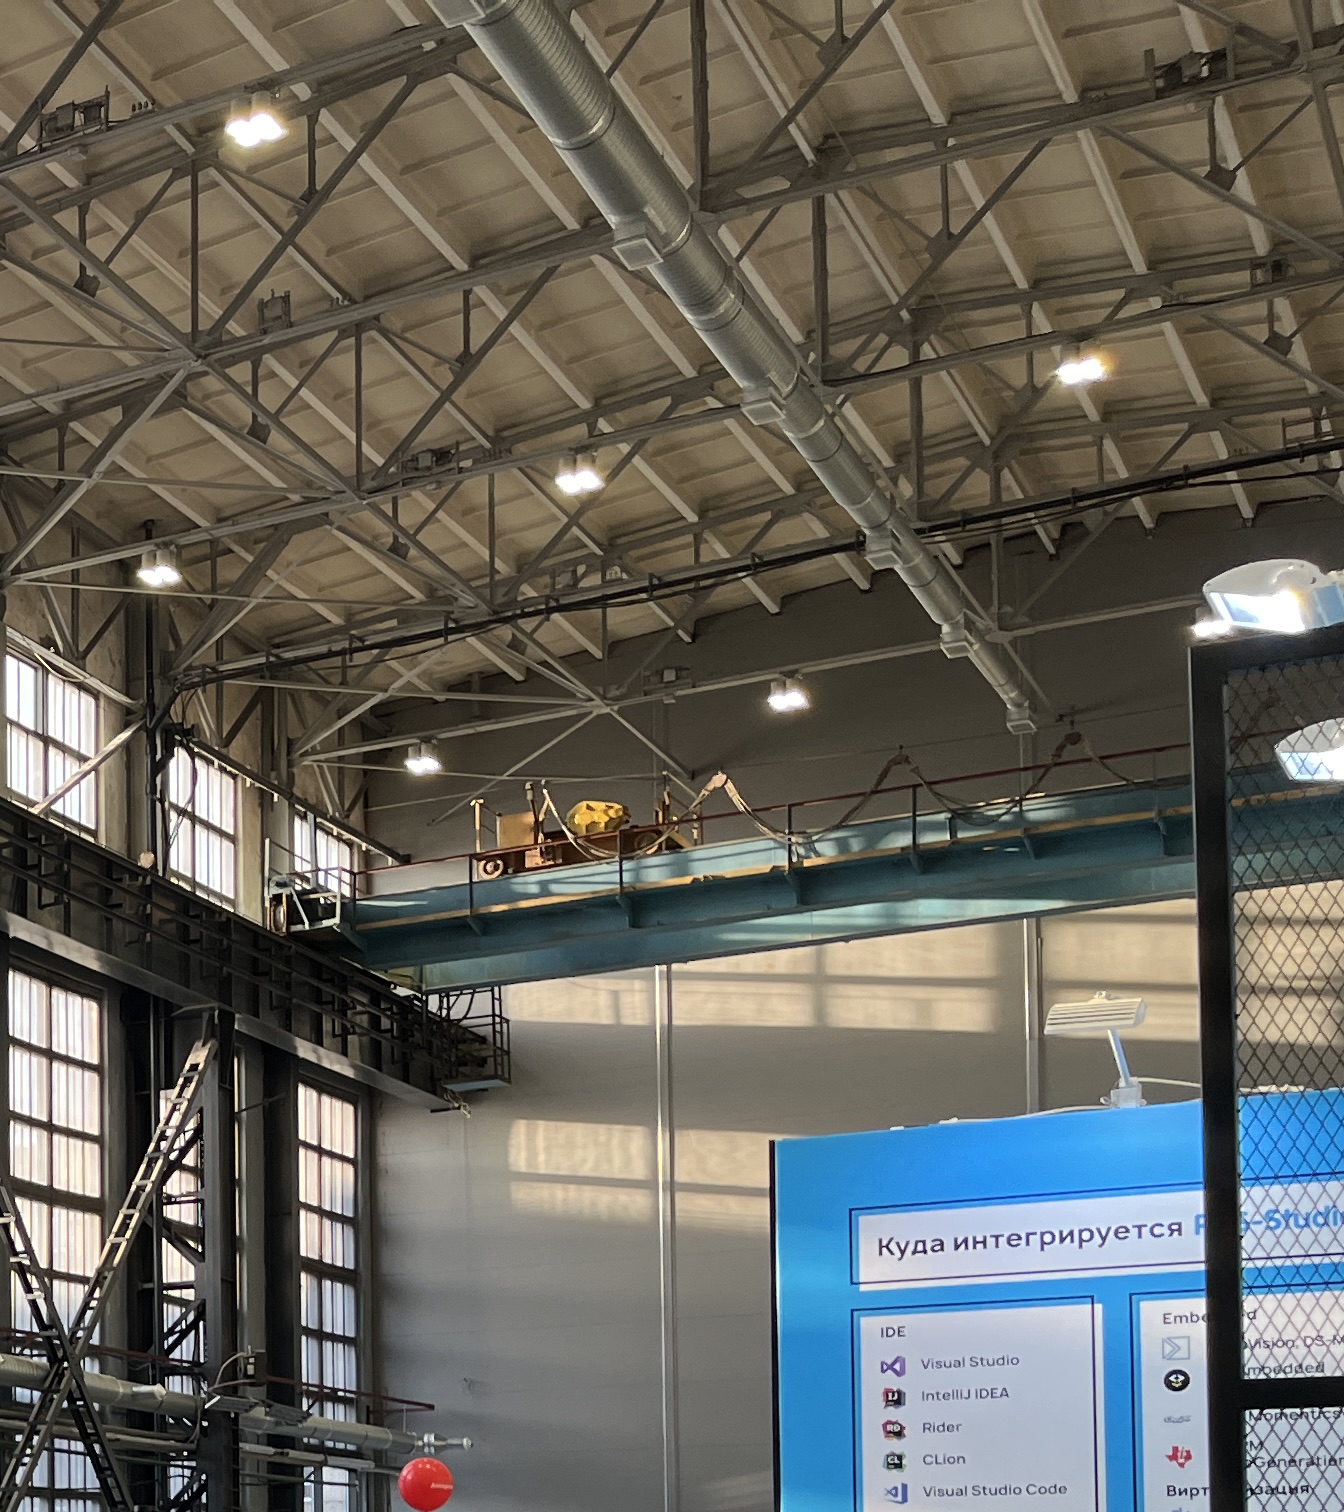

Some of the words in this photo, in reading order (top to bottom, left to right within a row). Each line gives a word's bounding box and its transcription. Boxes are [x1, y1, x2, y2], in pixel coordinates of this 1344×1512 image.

[878, 1235, 945, 1261] Куда
[953, 1219, 1184, 1252] интегрируется
[880, 1326, 906, 1338] IDE
[921, 1357, 965, 1370] Visual
[969, 1354, 1020, 1368] Studio
[1245, 1361, 1325, 1376] mbedded
[921, 1388, 971, 1402] IntelliJ
[975, 1387, 1010, 1400] IDEA
[922, 1421, 962, 1434] Rider
[922, 1453, 966, 1466] CLion
[923, 1485, 967, 1497] Visual
[971, 1484, 1023, 1496] Studio
[1026, 1483, 1068, 1496] Code
